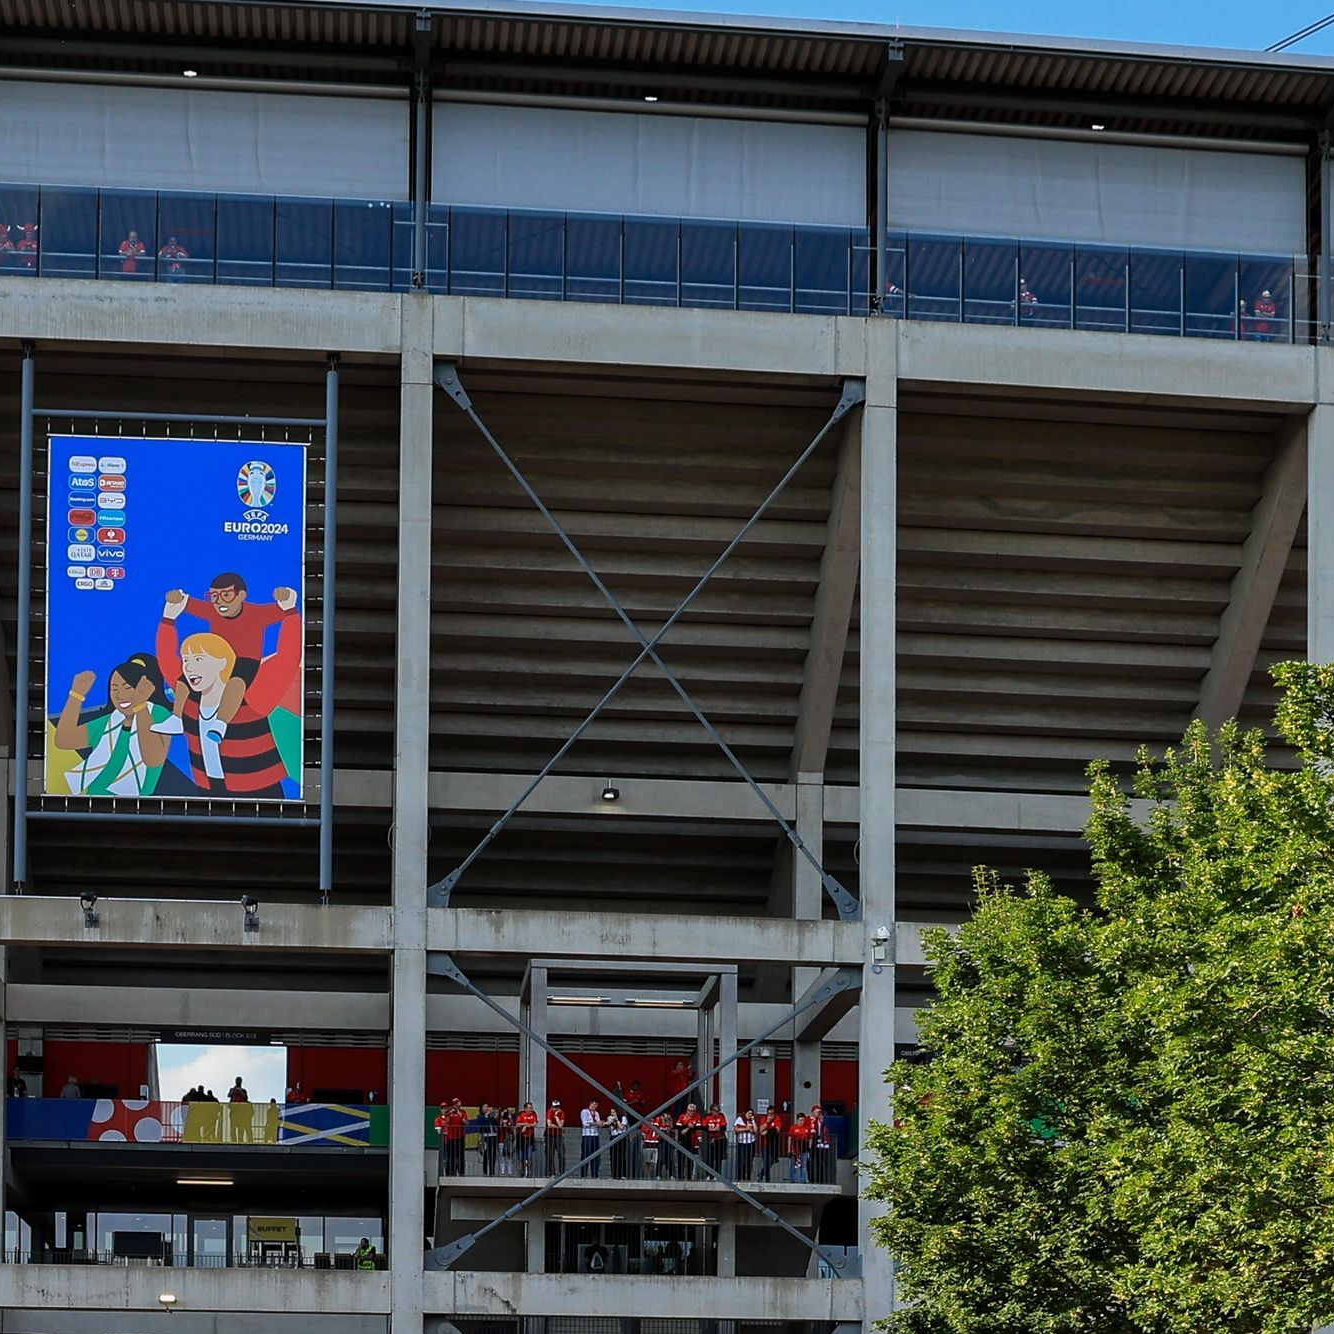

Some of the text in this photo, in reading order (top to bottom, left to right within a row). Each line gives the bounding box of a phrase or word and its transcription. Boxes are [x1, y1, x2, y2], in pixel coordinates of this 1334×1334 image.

[244, 510, 268, 521] UEFA
[224, 522, 289, 534] EURO2024
[98, 549, 124, 557] vivo
